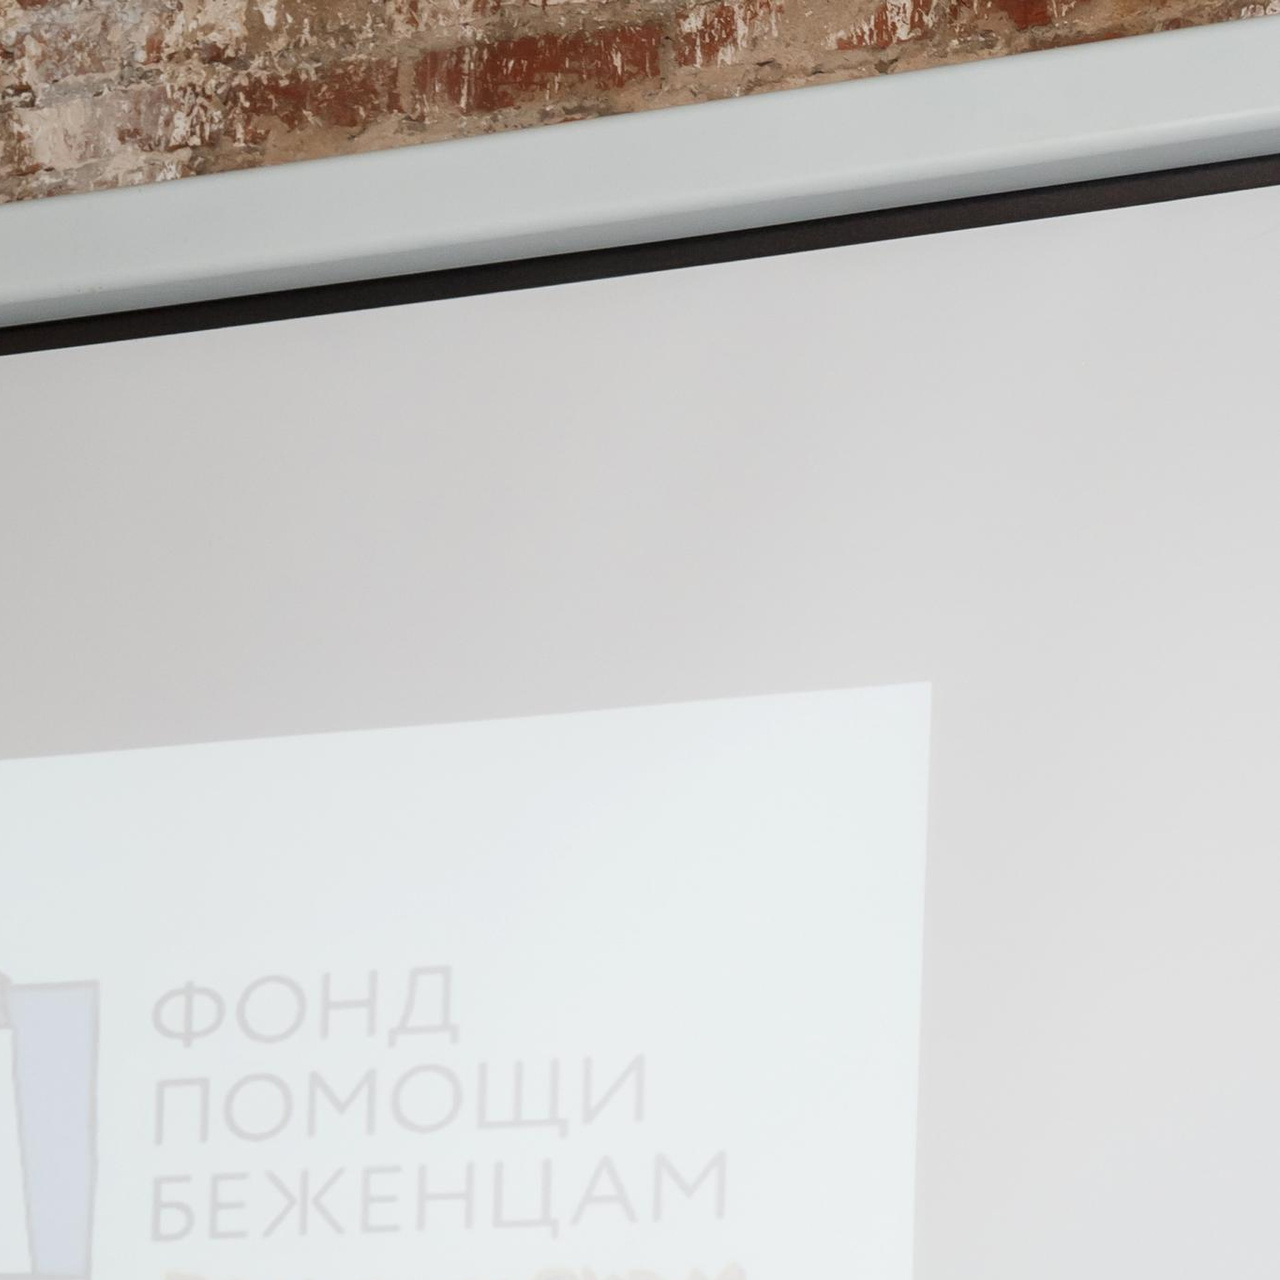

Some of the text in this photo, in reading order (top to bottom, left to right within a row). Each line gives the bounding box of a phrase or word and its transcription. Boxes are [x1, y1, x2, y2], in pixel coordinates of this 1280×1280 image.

[151, 965, 460, 1049] ФОНД
[154, 1052, 646, 1146] ПОМОЩИ
[150, 1150, 728, 1242] БЕЖЕНЦАМ
